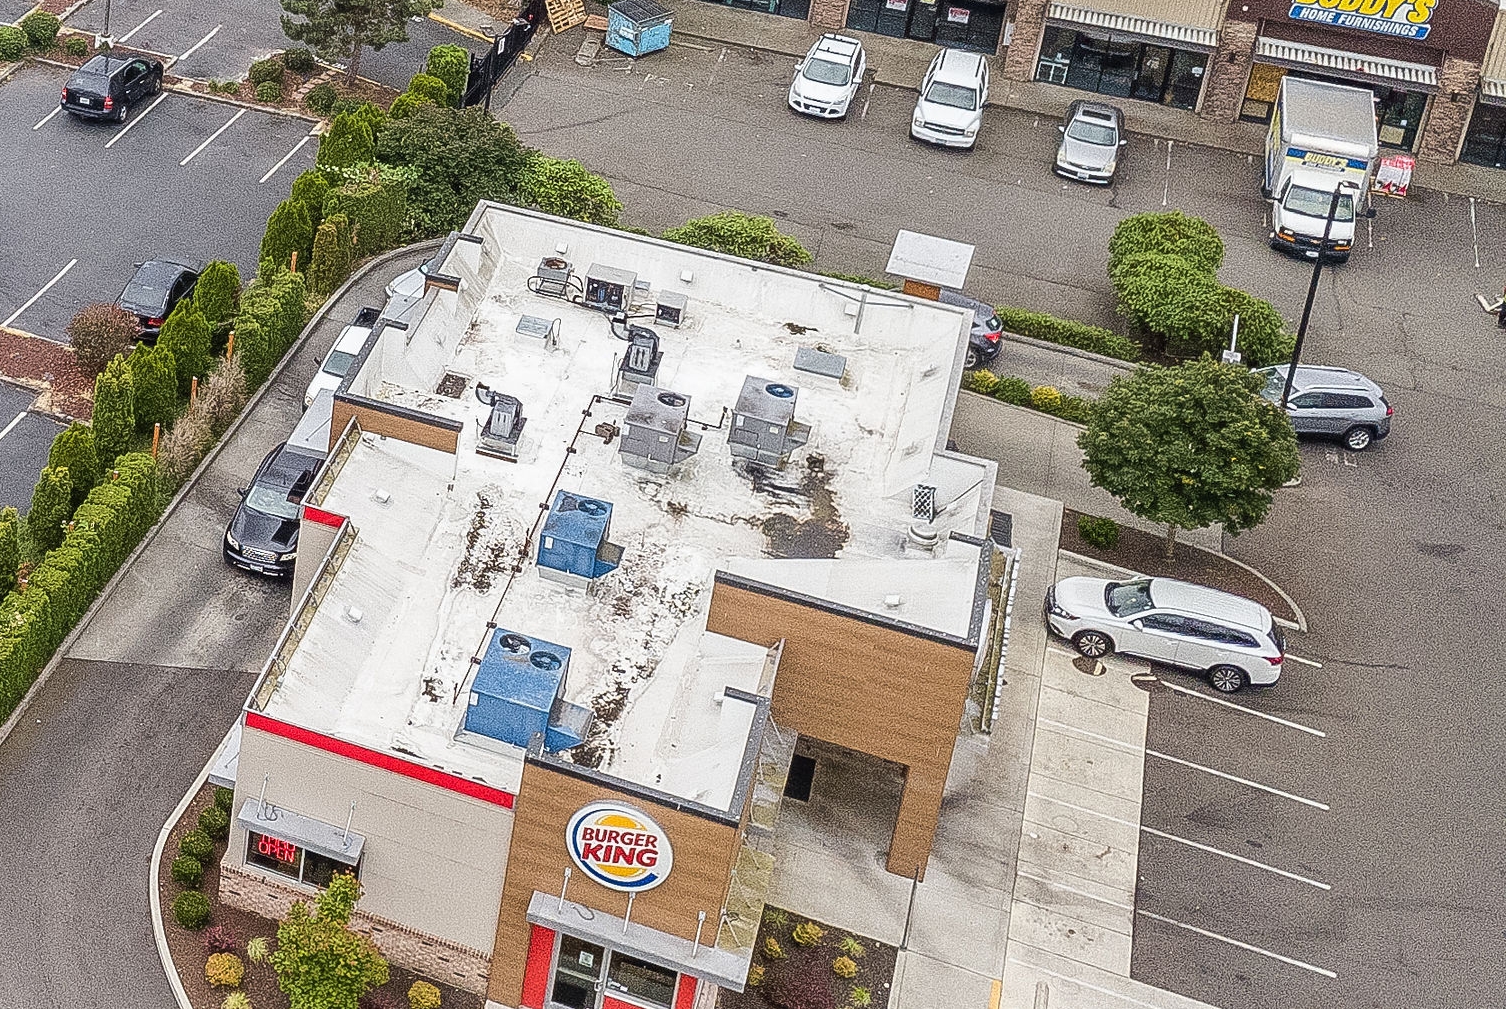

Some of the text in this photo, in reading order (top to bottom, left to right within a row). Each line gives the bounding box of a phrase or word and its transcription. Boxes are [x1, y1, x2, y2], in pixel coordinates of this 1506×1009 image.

[1299, 7, 1419, 38] HOME FURNISHINGS
[1305, 151, 1349, 168] BUDDY'S
[581, 827, 658, 848] BURGER
[258, 841, 295, 863] OPEN
[581, 843, 659, 867] KING
